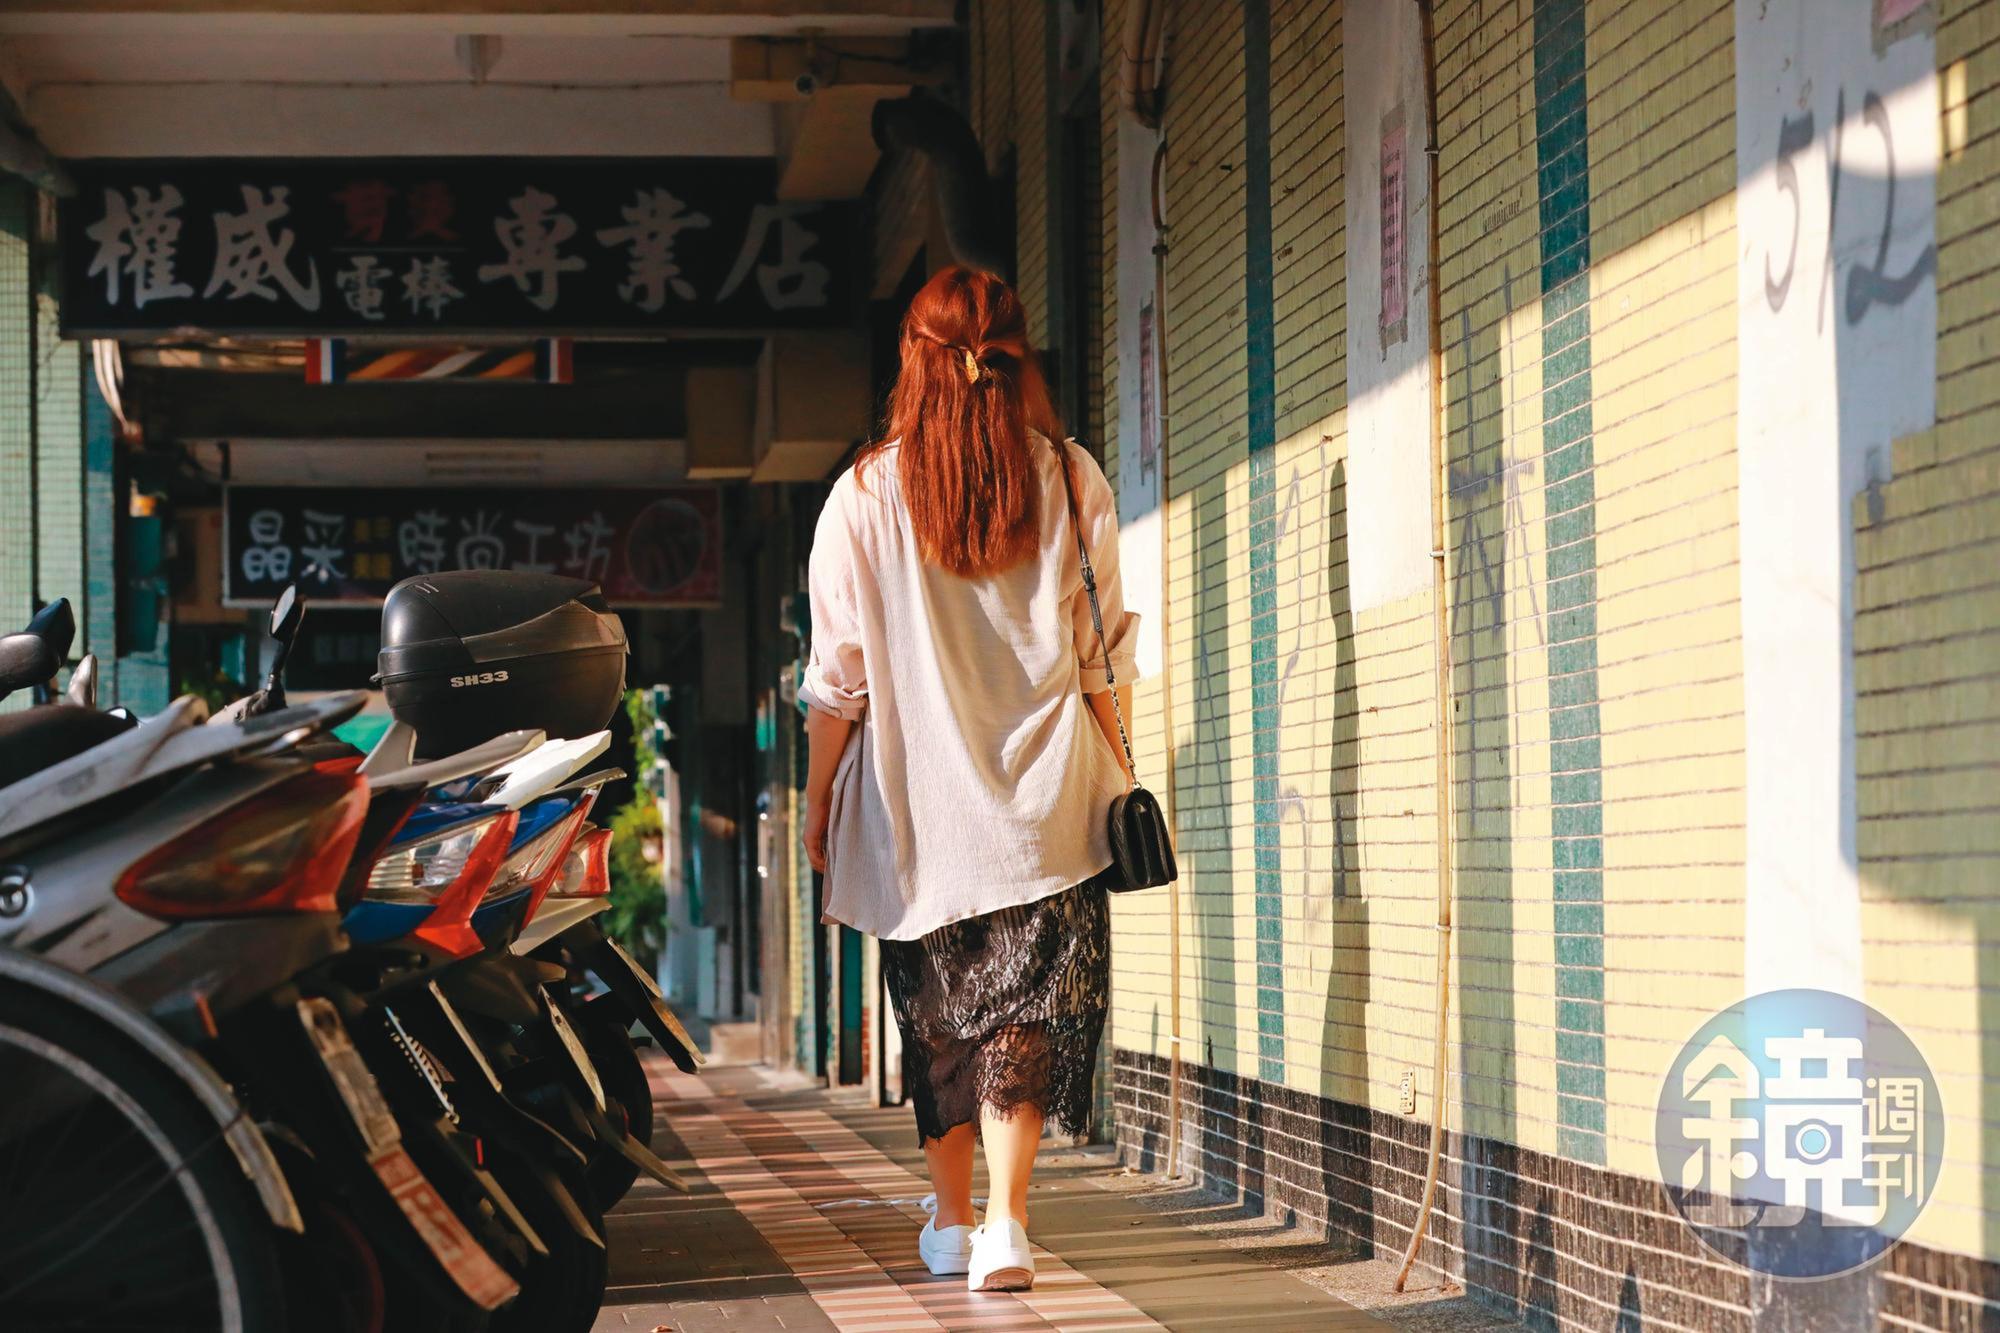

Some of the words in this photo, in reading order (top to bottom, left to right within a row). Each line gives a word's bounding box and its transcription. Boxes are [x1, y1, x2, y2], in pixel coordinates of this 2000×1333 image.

[85, 183, 322, 311] 權威
[477, 186, 830, 313] 專業店
[335, 254, 466, 321] 電棒
[450, 670, 510, 689] SH33
